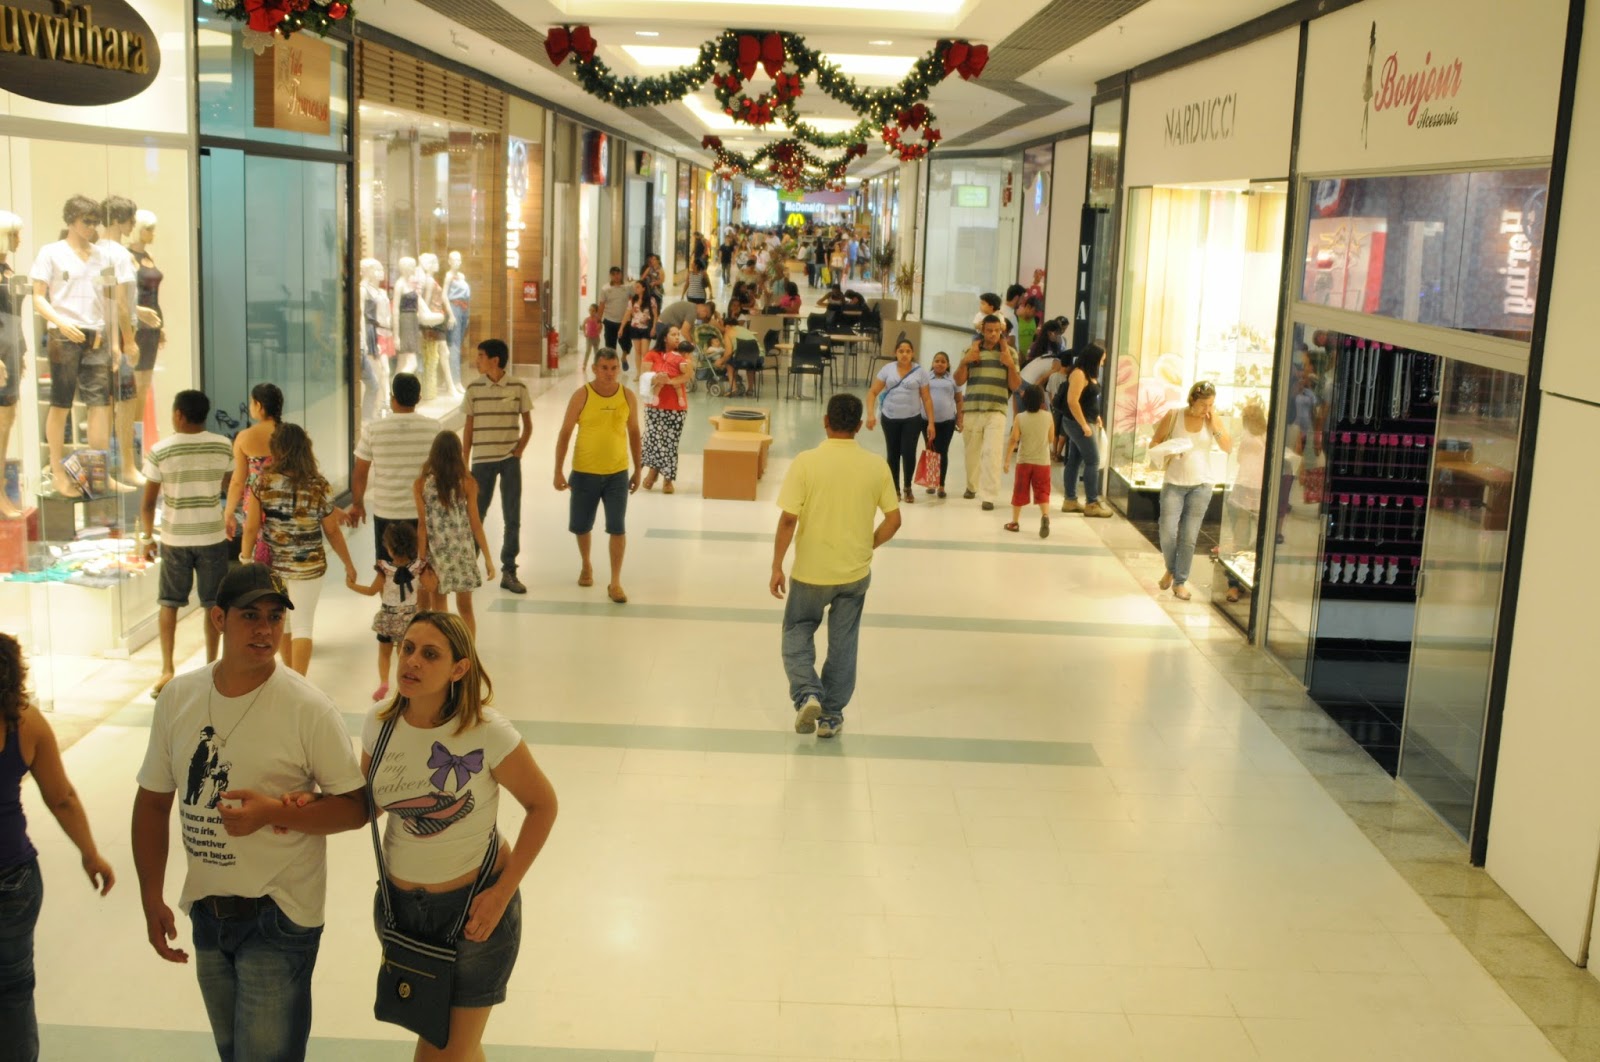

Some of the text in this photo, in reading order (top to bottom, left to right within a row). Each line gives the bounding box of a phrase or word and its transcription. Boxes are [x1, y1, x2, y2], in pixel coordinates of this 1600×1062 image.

[1375, 51, 1462, 126] Bonjour
[1164, 92, 1237, 147] NARDUCCI
[784, 201, 825, 213] McDonald's
[1076, 244, 1091, 321] VIA
[206, 815, 223, 825] ach
